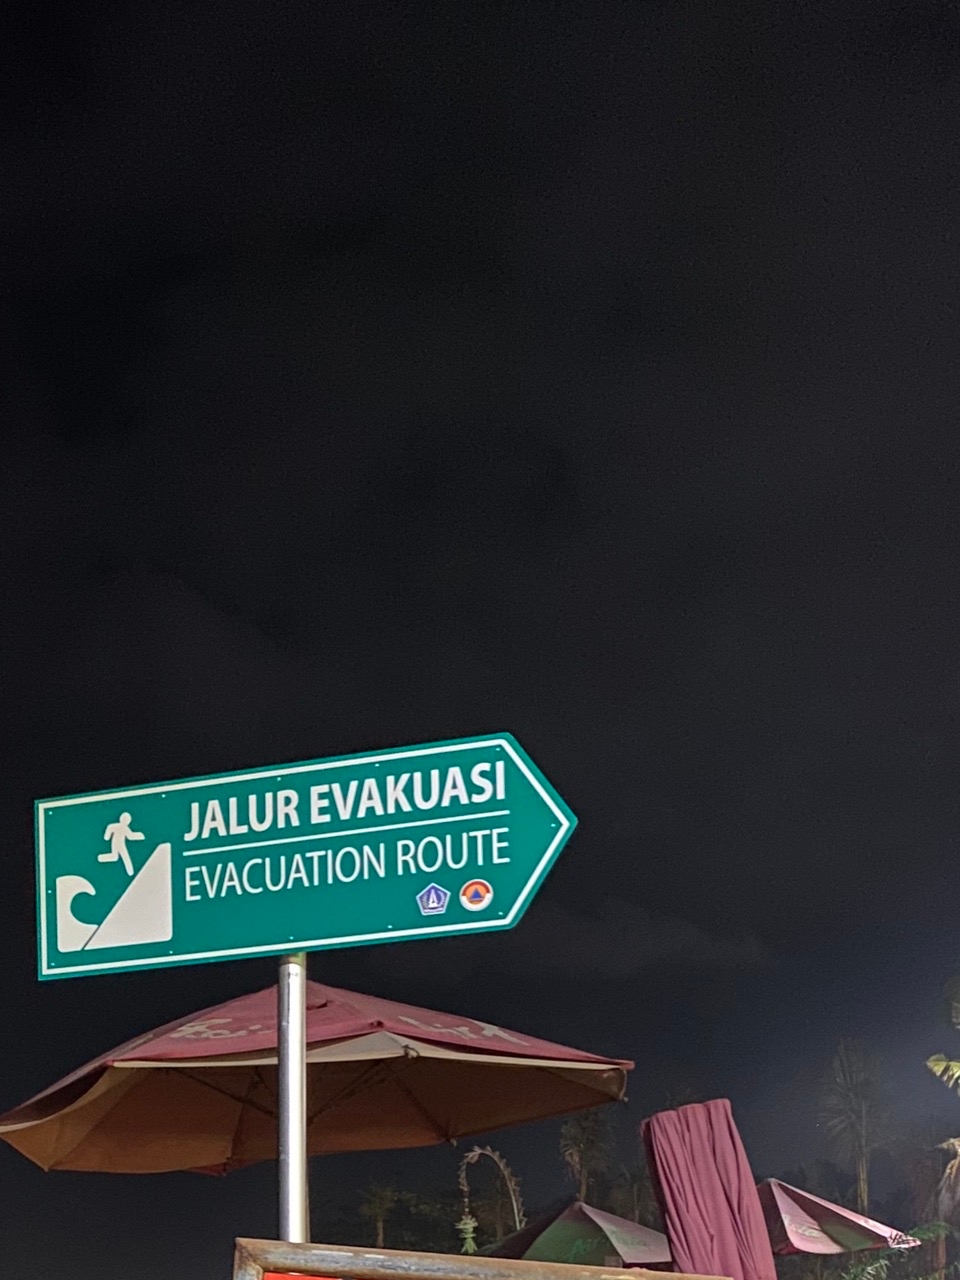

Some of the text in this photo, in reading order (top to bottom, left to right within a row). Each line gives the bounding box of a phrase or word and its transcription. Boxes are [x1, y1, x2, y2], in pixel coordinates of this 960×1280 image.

[183, 760, 506, 842] JALUR EVAKUASI
[185, 827, 511, 902] EVACUATION ROUTE
